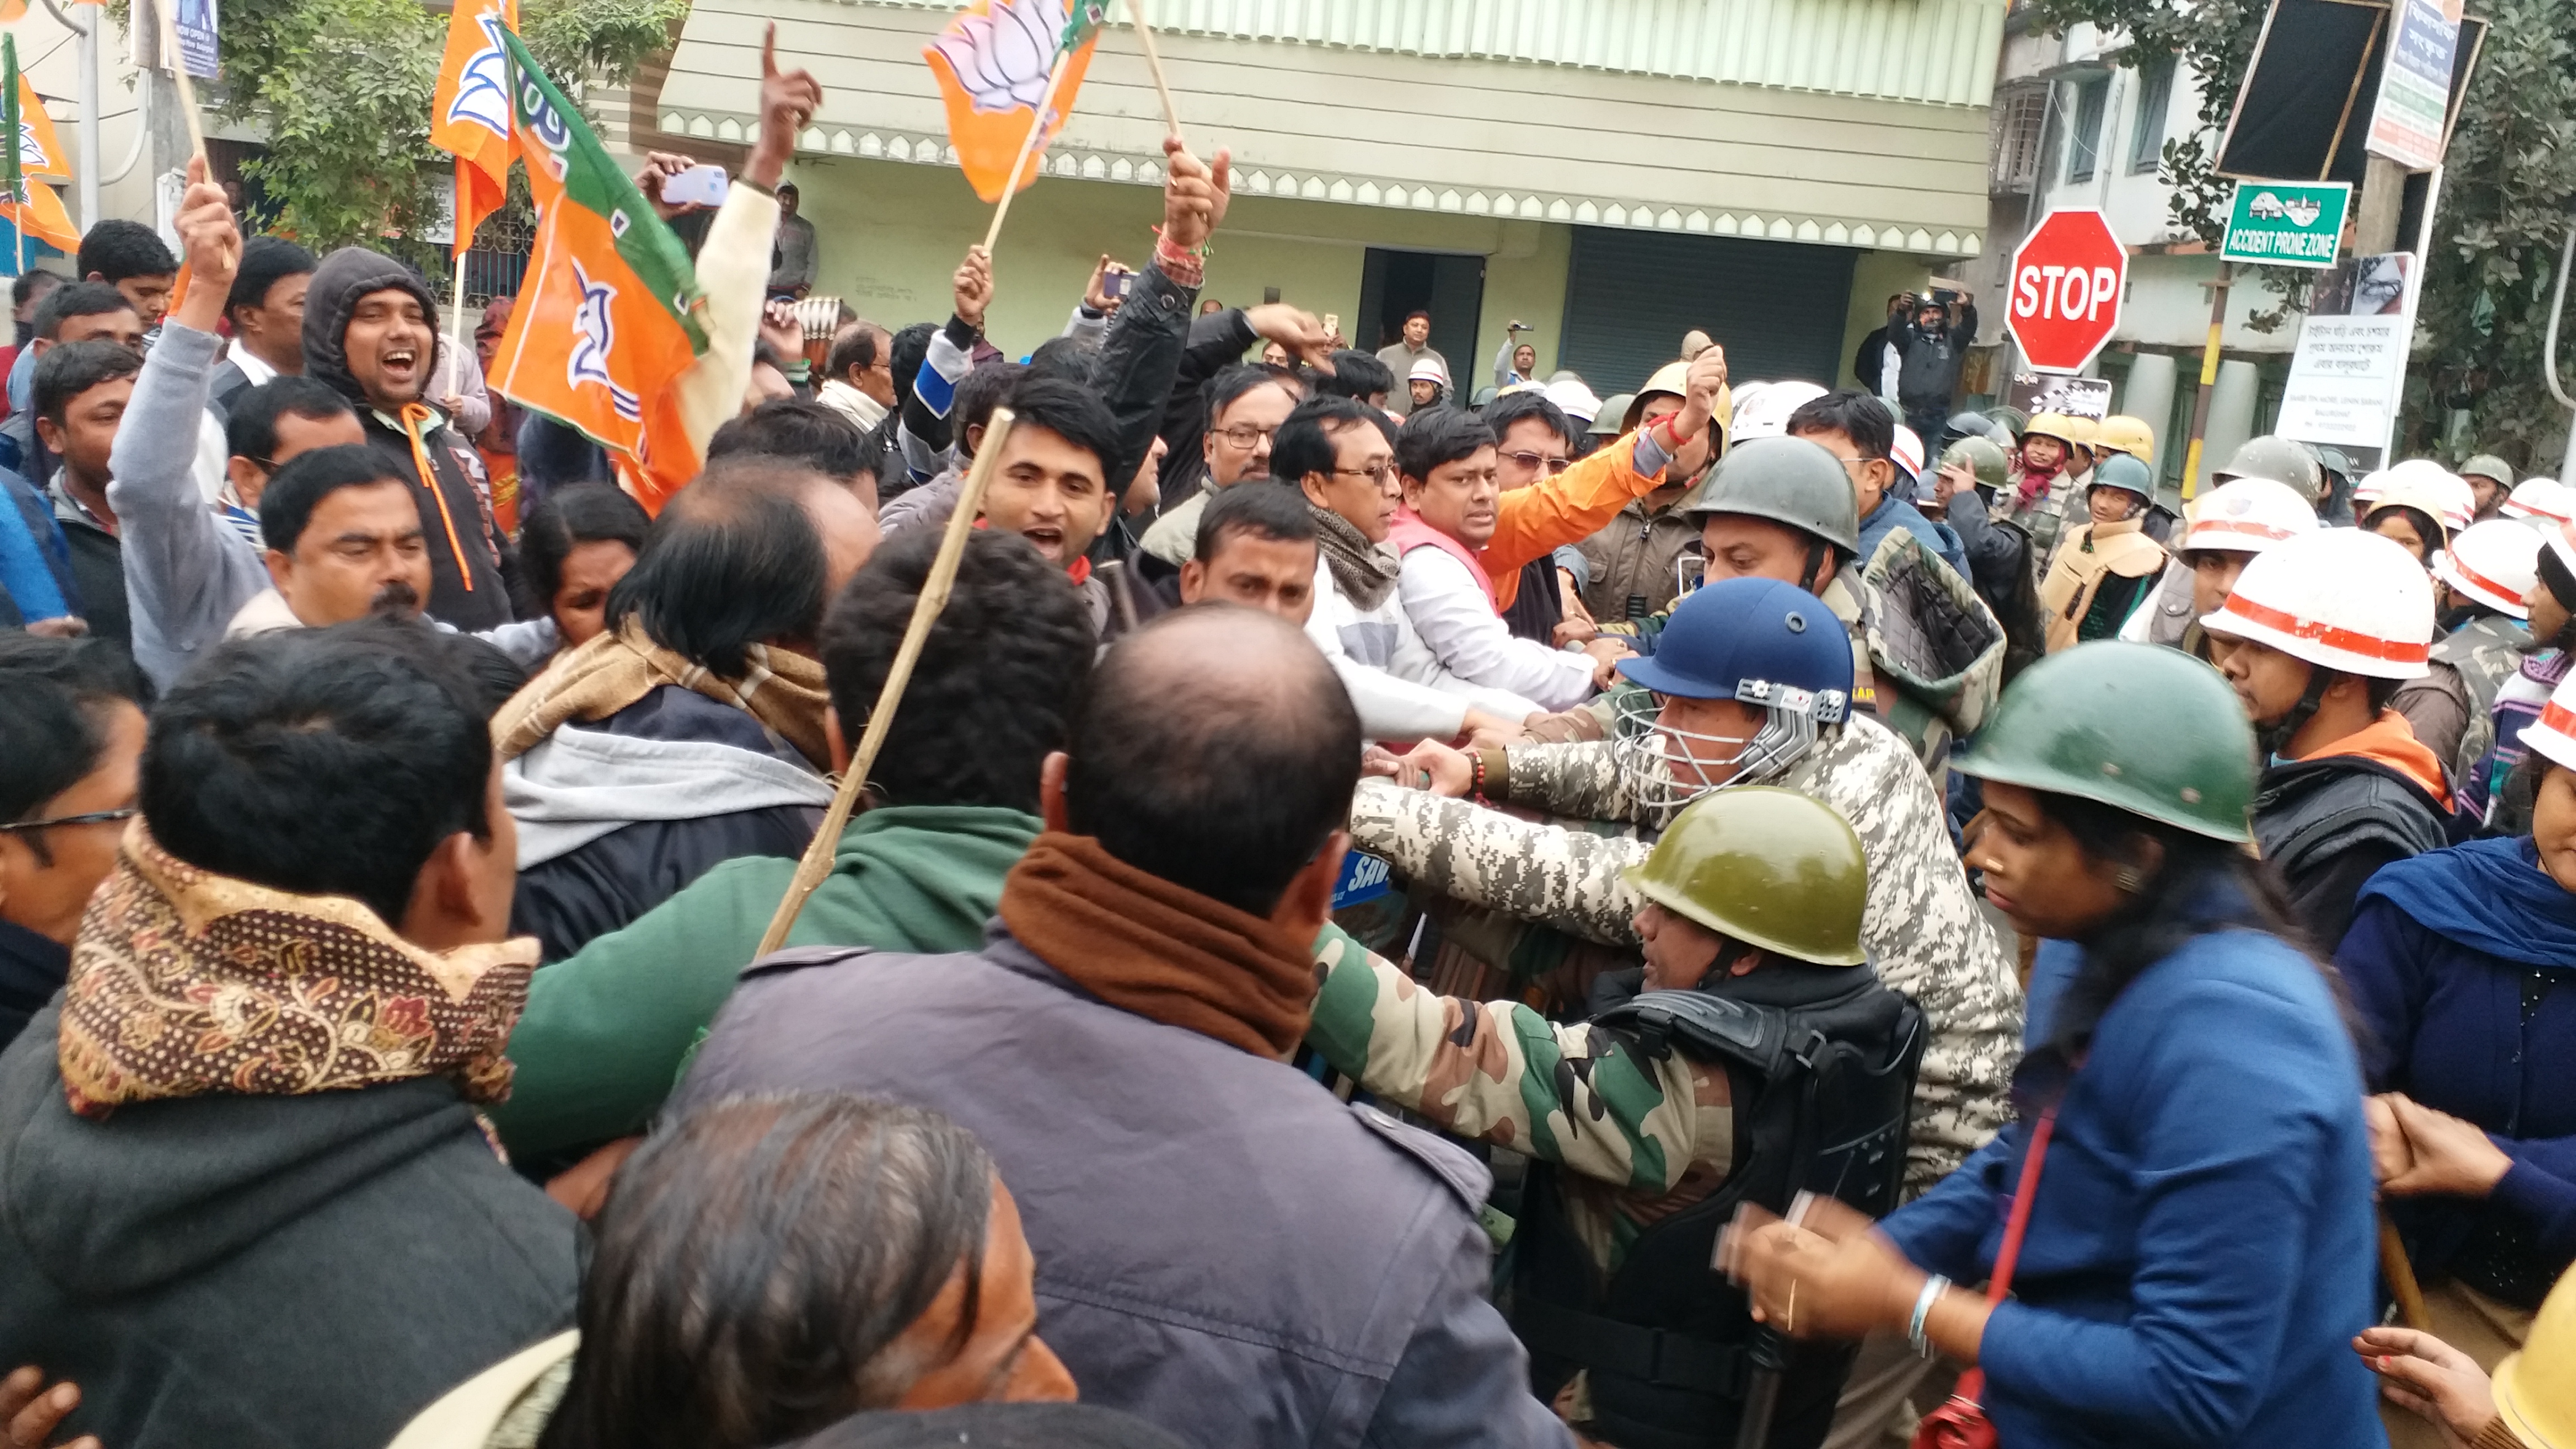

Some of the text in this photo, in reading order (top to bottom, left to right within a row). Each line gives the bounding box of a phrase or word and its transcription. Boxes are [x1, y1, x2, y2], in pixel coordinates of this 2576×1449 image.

[2228, 228, 2336, 258] ACCIDENT PRONE ZONE
[2015, 265, 2116, 321] STOP
[1347, 855, 1390, 892] SAV
